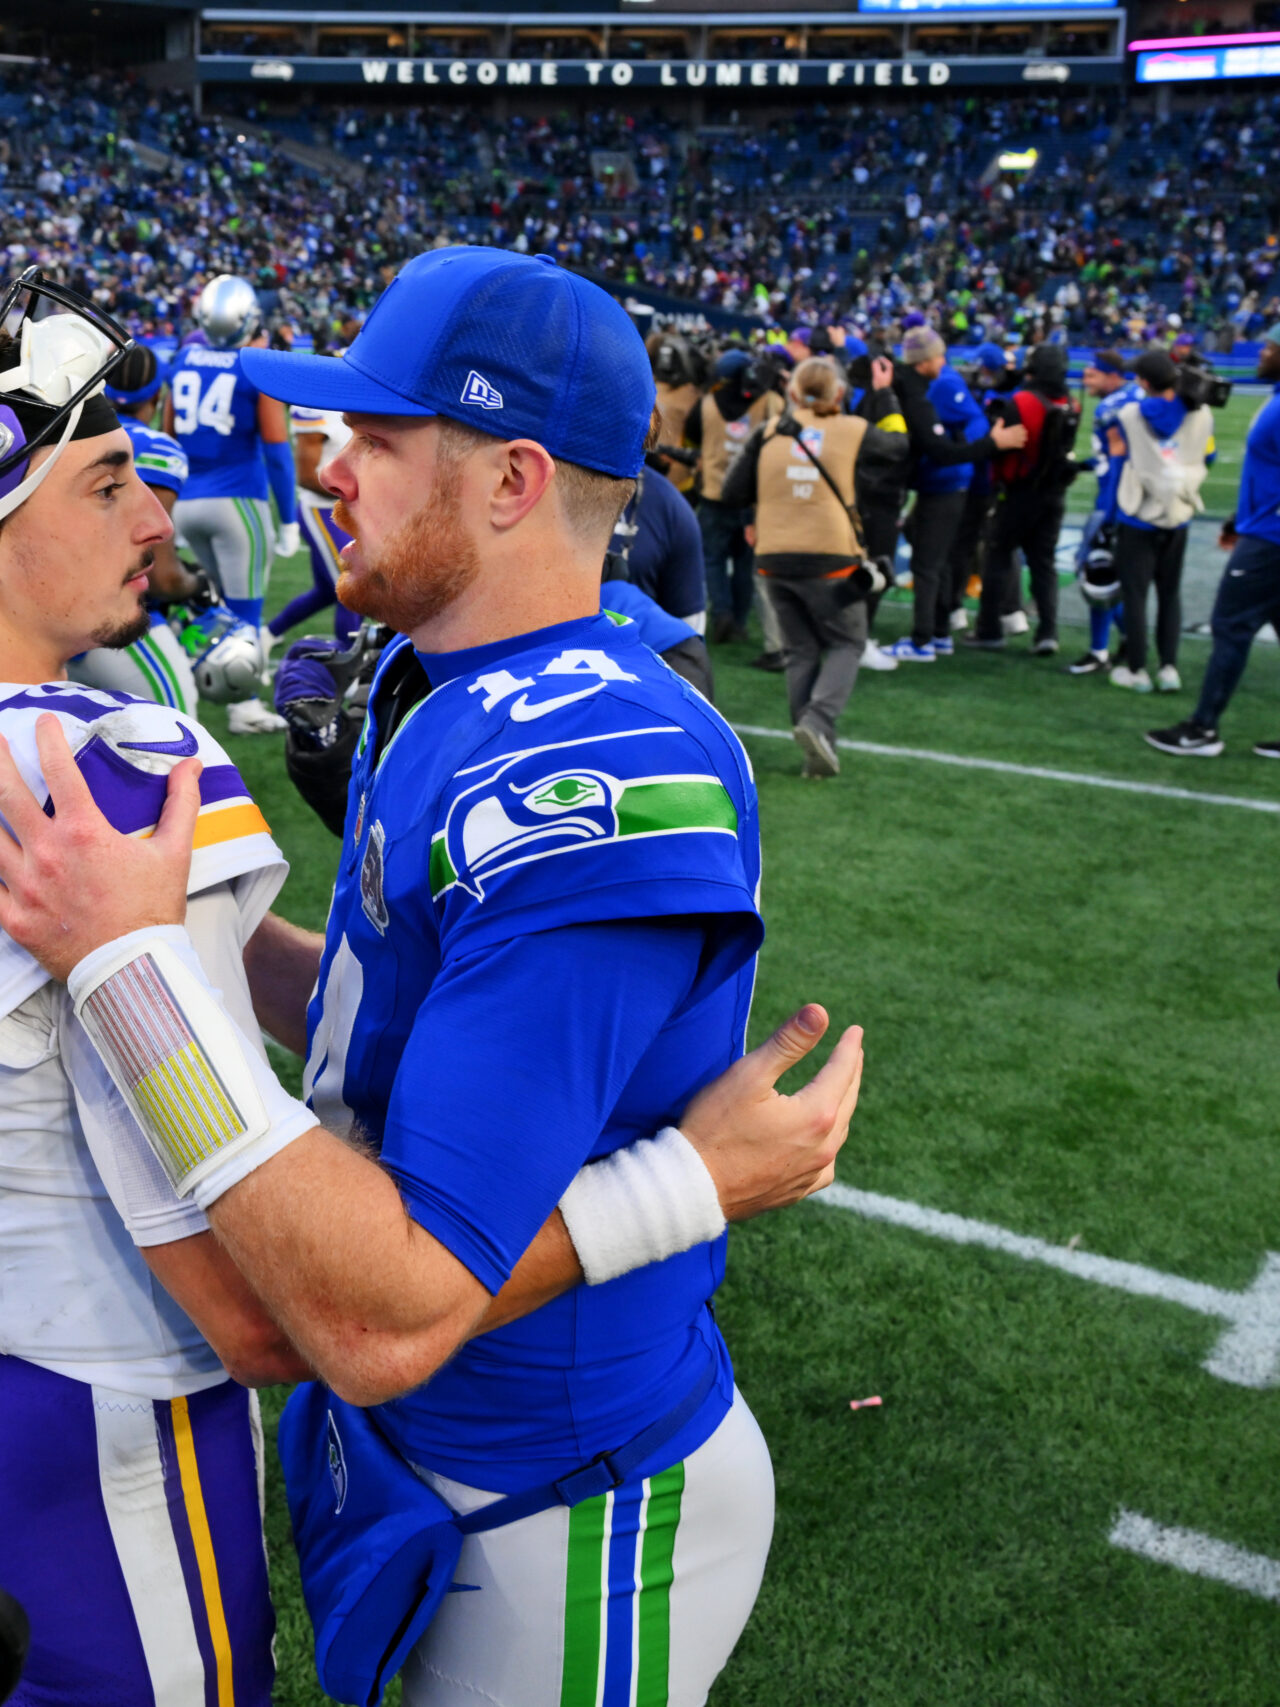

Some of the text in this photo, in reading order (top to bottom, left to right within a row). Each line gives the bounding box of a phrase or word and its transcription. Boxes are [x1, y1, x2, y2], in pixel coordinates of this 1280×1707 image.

[362, 61, 950, 86] WELCOME TO LUMEN FIELD
[173, 370, 237, 436] 94
[467, 649, 642, 713] 14
